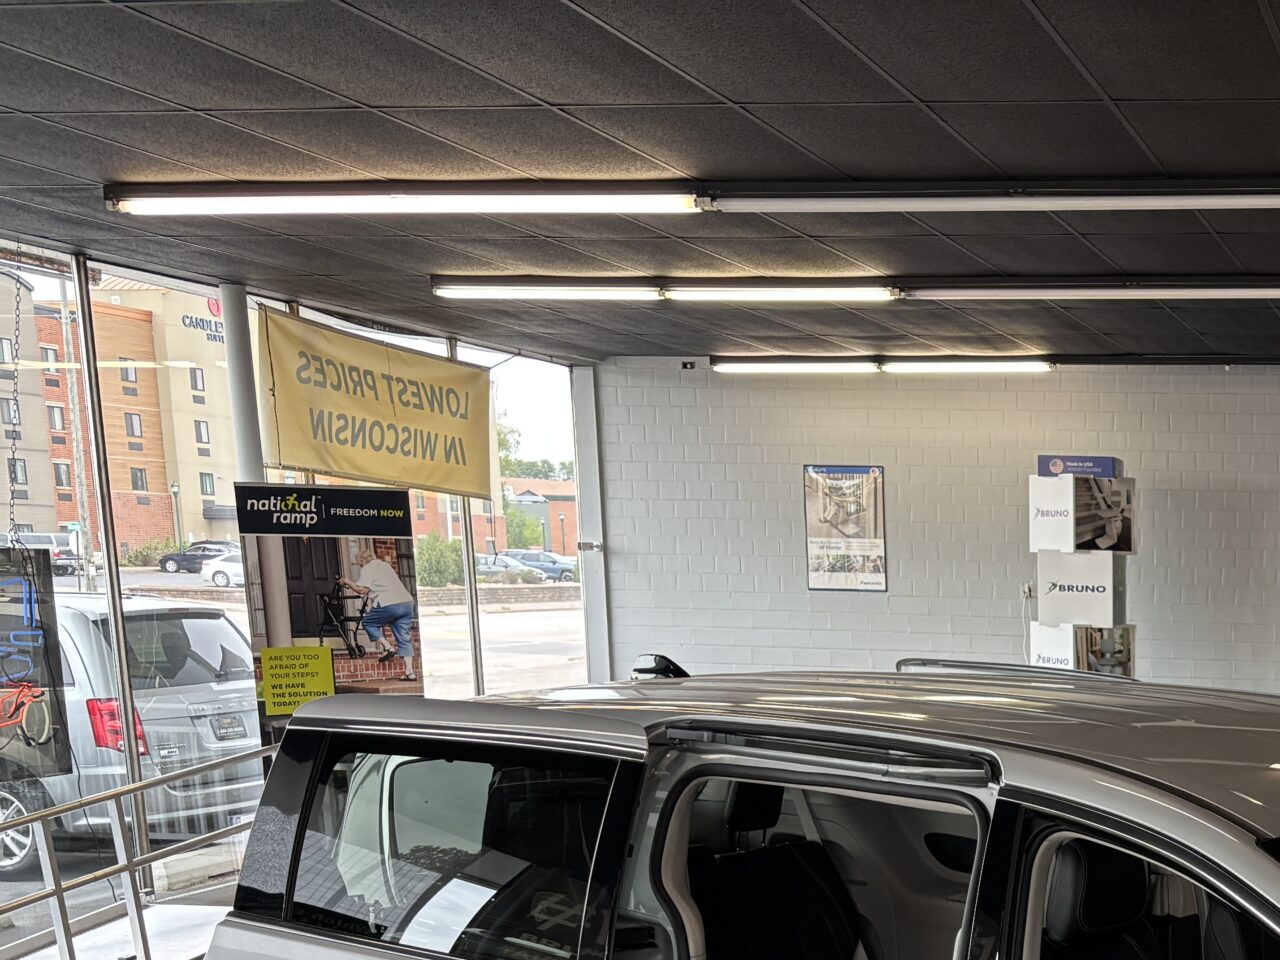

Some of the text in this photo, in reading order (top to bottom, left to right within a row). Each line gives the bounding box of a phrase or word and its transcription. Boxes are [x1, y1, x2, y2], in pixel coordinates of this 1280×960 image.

[181, 315, 224, 334] CANDLE
[247, 493, 317, 512] national
[330, 507, 404, 518] FREEDOM NOW
[1040, 509, 1070, 518] BRUNO
[272, 511, 318, 528] ramp
[1058, 584, 1106, 593] BRUNO
[1041, 656, 1070, 666] BRUNO
[269, 663, 297, 671] AFRAID
[288, 690, 328, 698] SOLUTION
